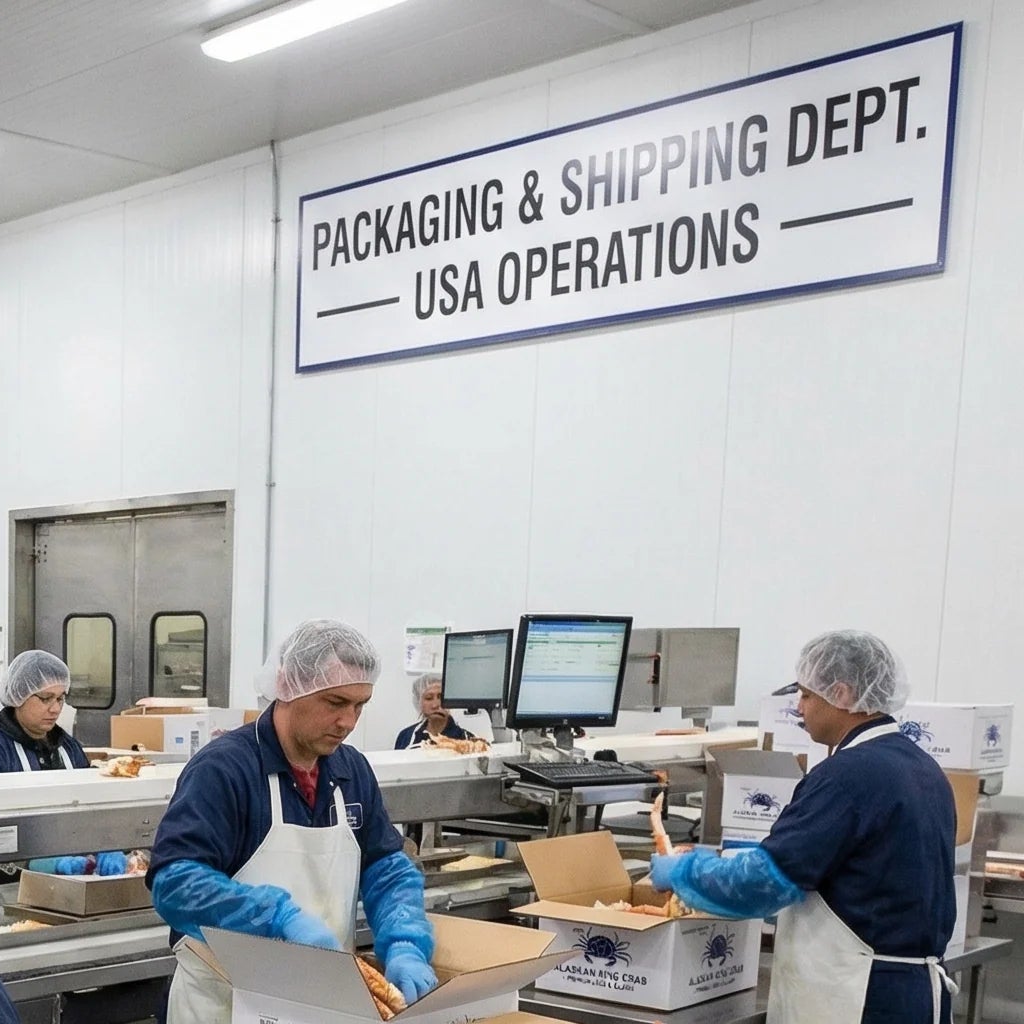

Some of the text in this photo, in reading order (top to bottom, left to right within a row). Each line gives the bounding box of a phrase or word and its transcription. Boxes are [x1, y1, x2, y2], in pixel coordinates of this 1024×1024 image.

[312, 75, 928, 271] PACKAGING & SHIPPING DEPT.
[413, 201, 760, 320] USA OPERATIONS
